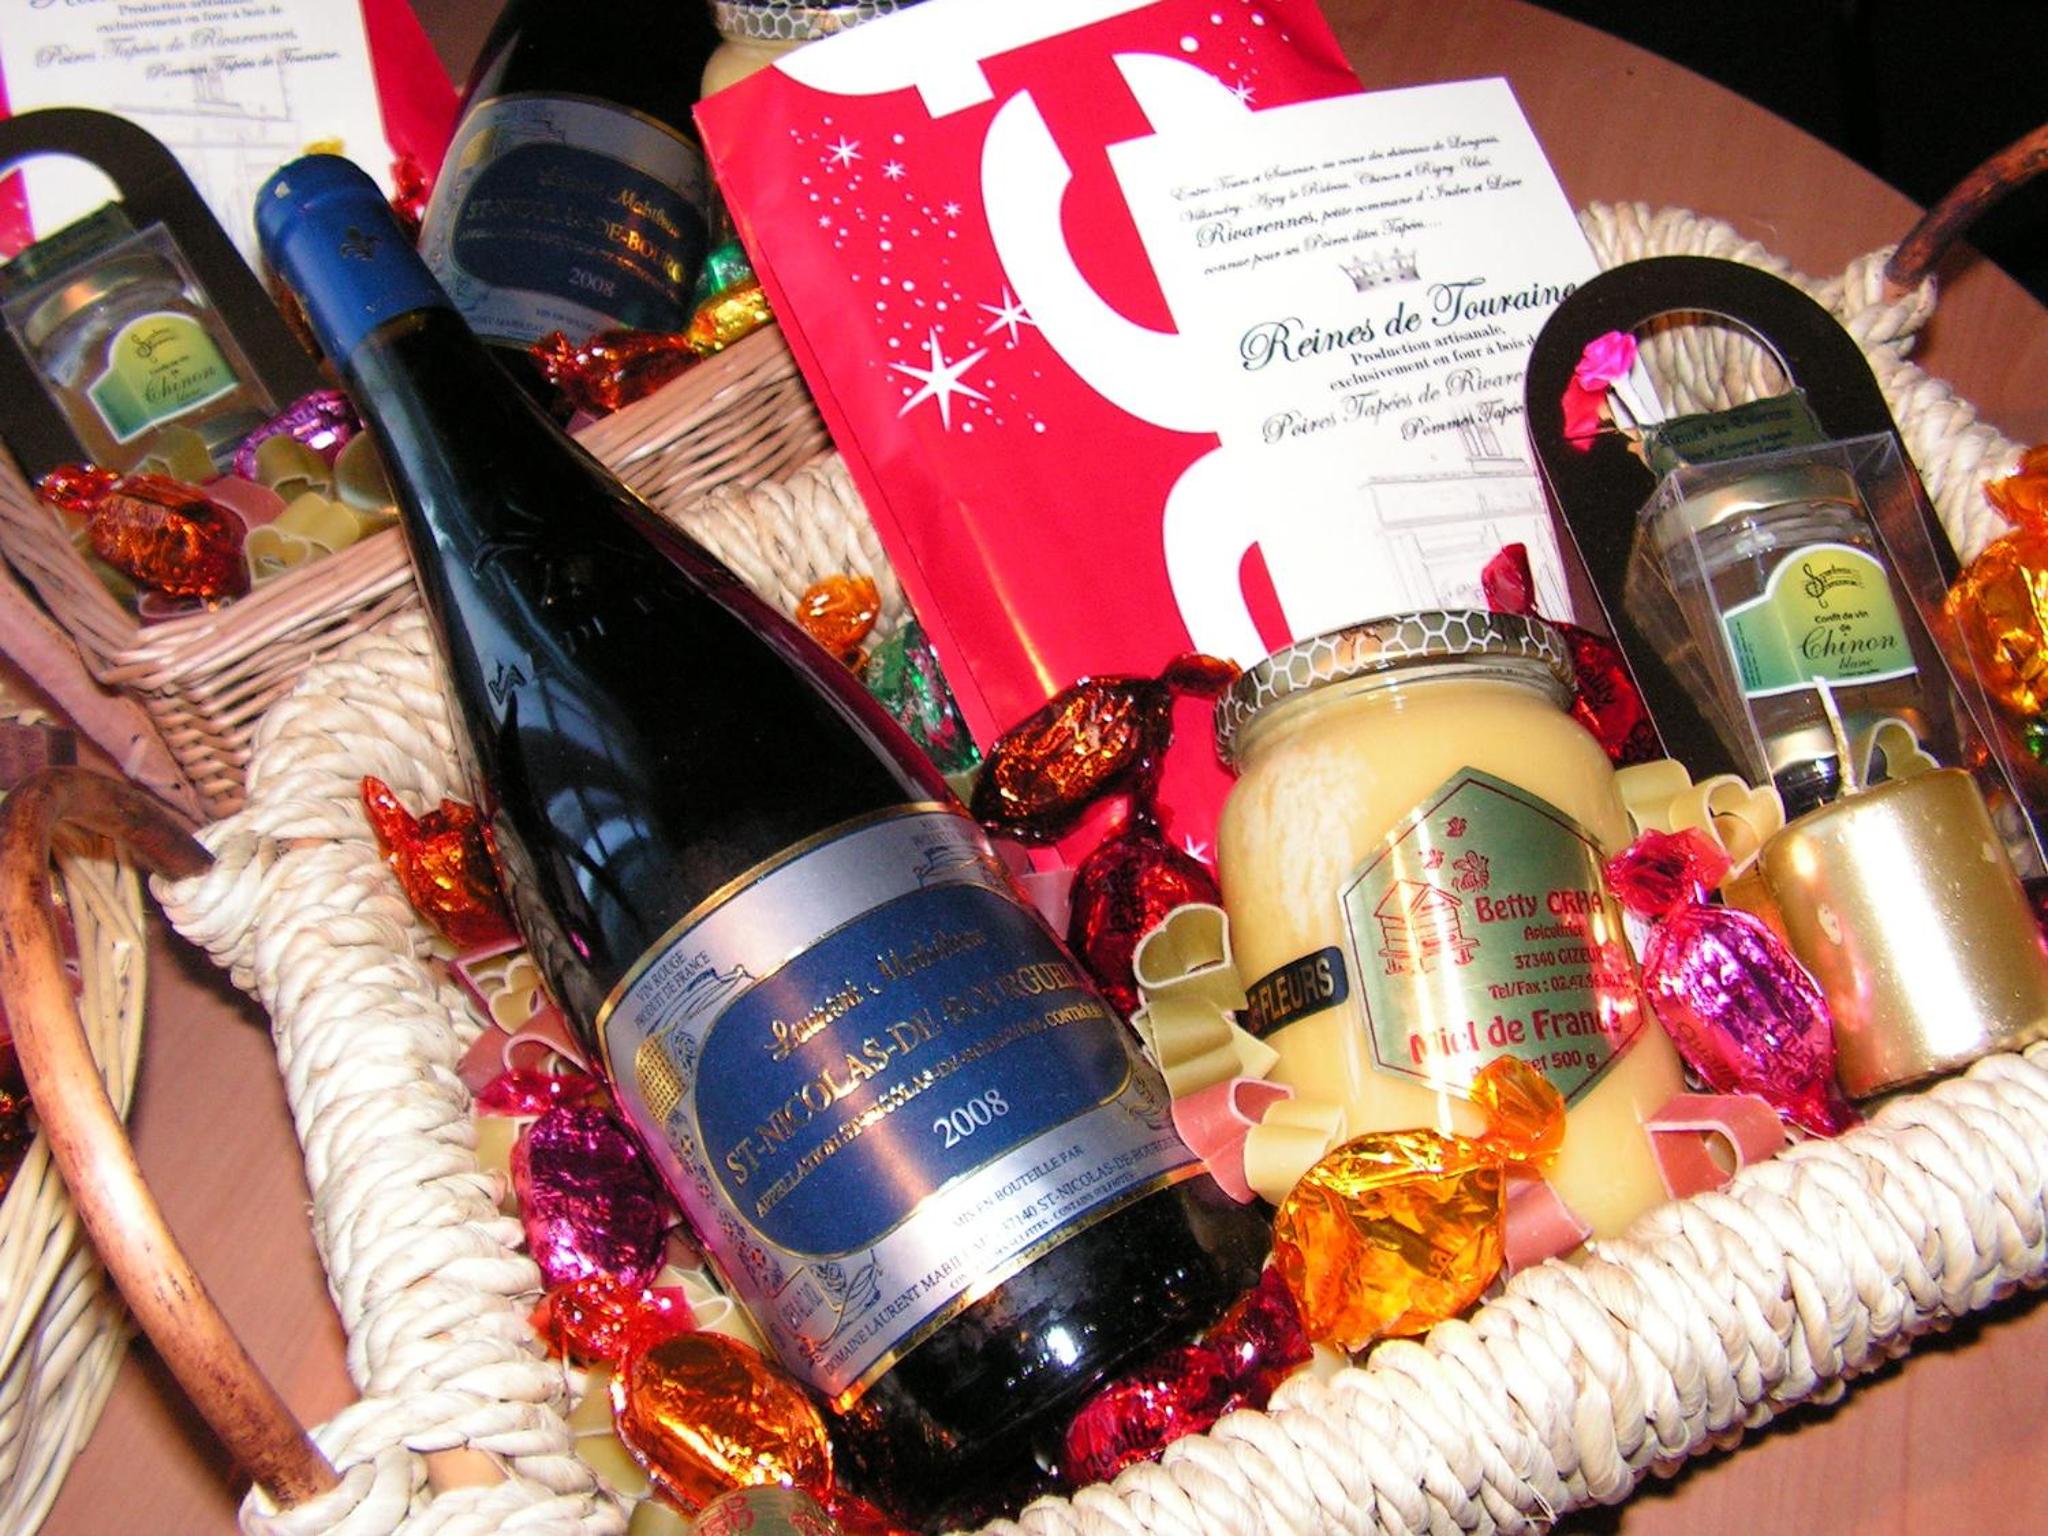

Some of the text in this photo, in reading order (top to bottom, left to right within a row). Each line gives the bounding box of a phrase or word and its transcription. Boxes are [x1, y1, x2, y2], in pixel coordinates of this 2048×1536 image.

[568, 266, 616, 298] 2008
[1239, 277, 1577, 371] Reines de Touraine
[1329, 356, 1430, 391] exclusivement
[1432, 354, 1450, 367] en
[1452, 345, 1483, 363] four
[1496, 338, 1526, 353] bois
[1527, 333, 1537, 348] d
[1350, 336, 1430, 367] Production
[1262, 366, 1525, 444] Poires Tapées de Rivare
[1400, 398, 1525, 442] Pommes Tapée
[1840, 623, 1852, 633] de
[1842, 611, 1853, 621] de
[1854, 609, 1869, 619] vin
[1798, 626, 1897, 661] Chinon
[1475, 892, 1538, 924] Betty
[634, 951, 685, 1002] VIN ROUGE
[672, 950, 711, 992] FRANCE
[1513, 952, 1556, 970] 37340
[1258, 956, 1336, 1026] FLEURS
[1409, 1020, 1481, 1065] Miel
[1486, 1015, 1526, 1048] de
[1551, 1049, 1582, 1069] 500
[1586, 1054, 1599, 1071] g
[933, 1088, 1010, 1150] 2008
[993, 1153, 1064, 1202] BOUTEILLE
[1060, 1144, 1086, 1165] PAR
[823, 1326, 869, 1377] DOMAINE
[865, 1283, 922, 1338] LAURENT
